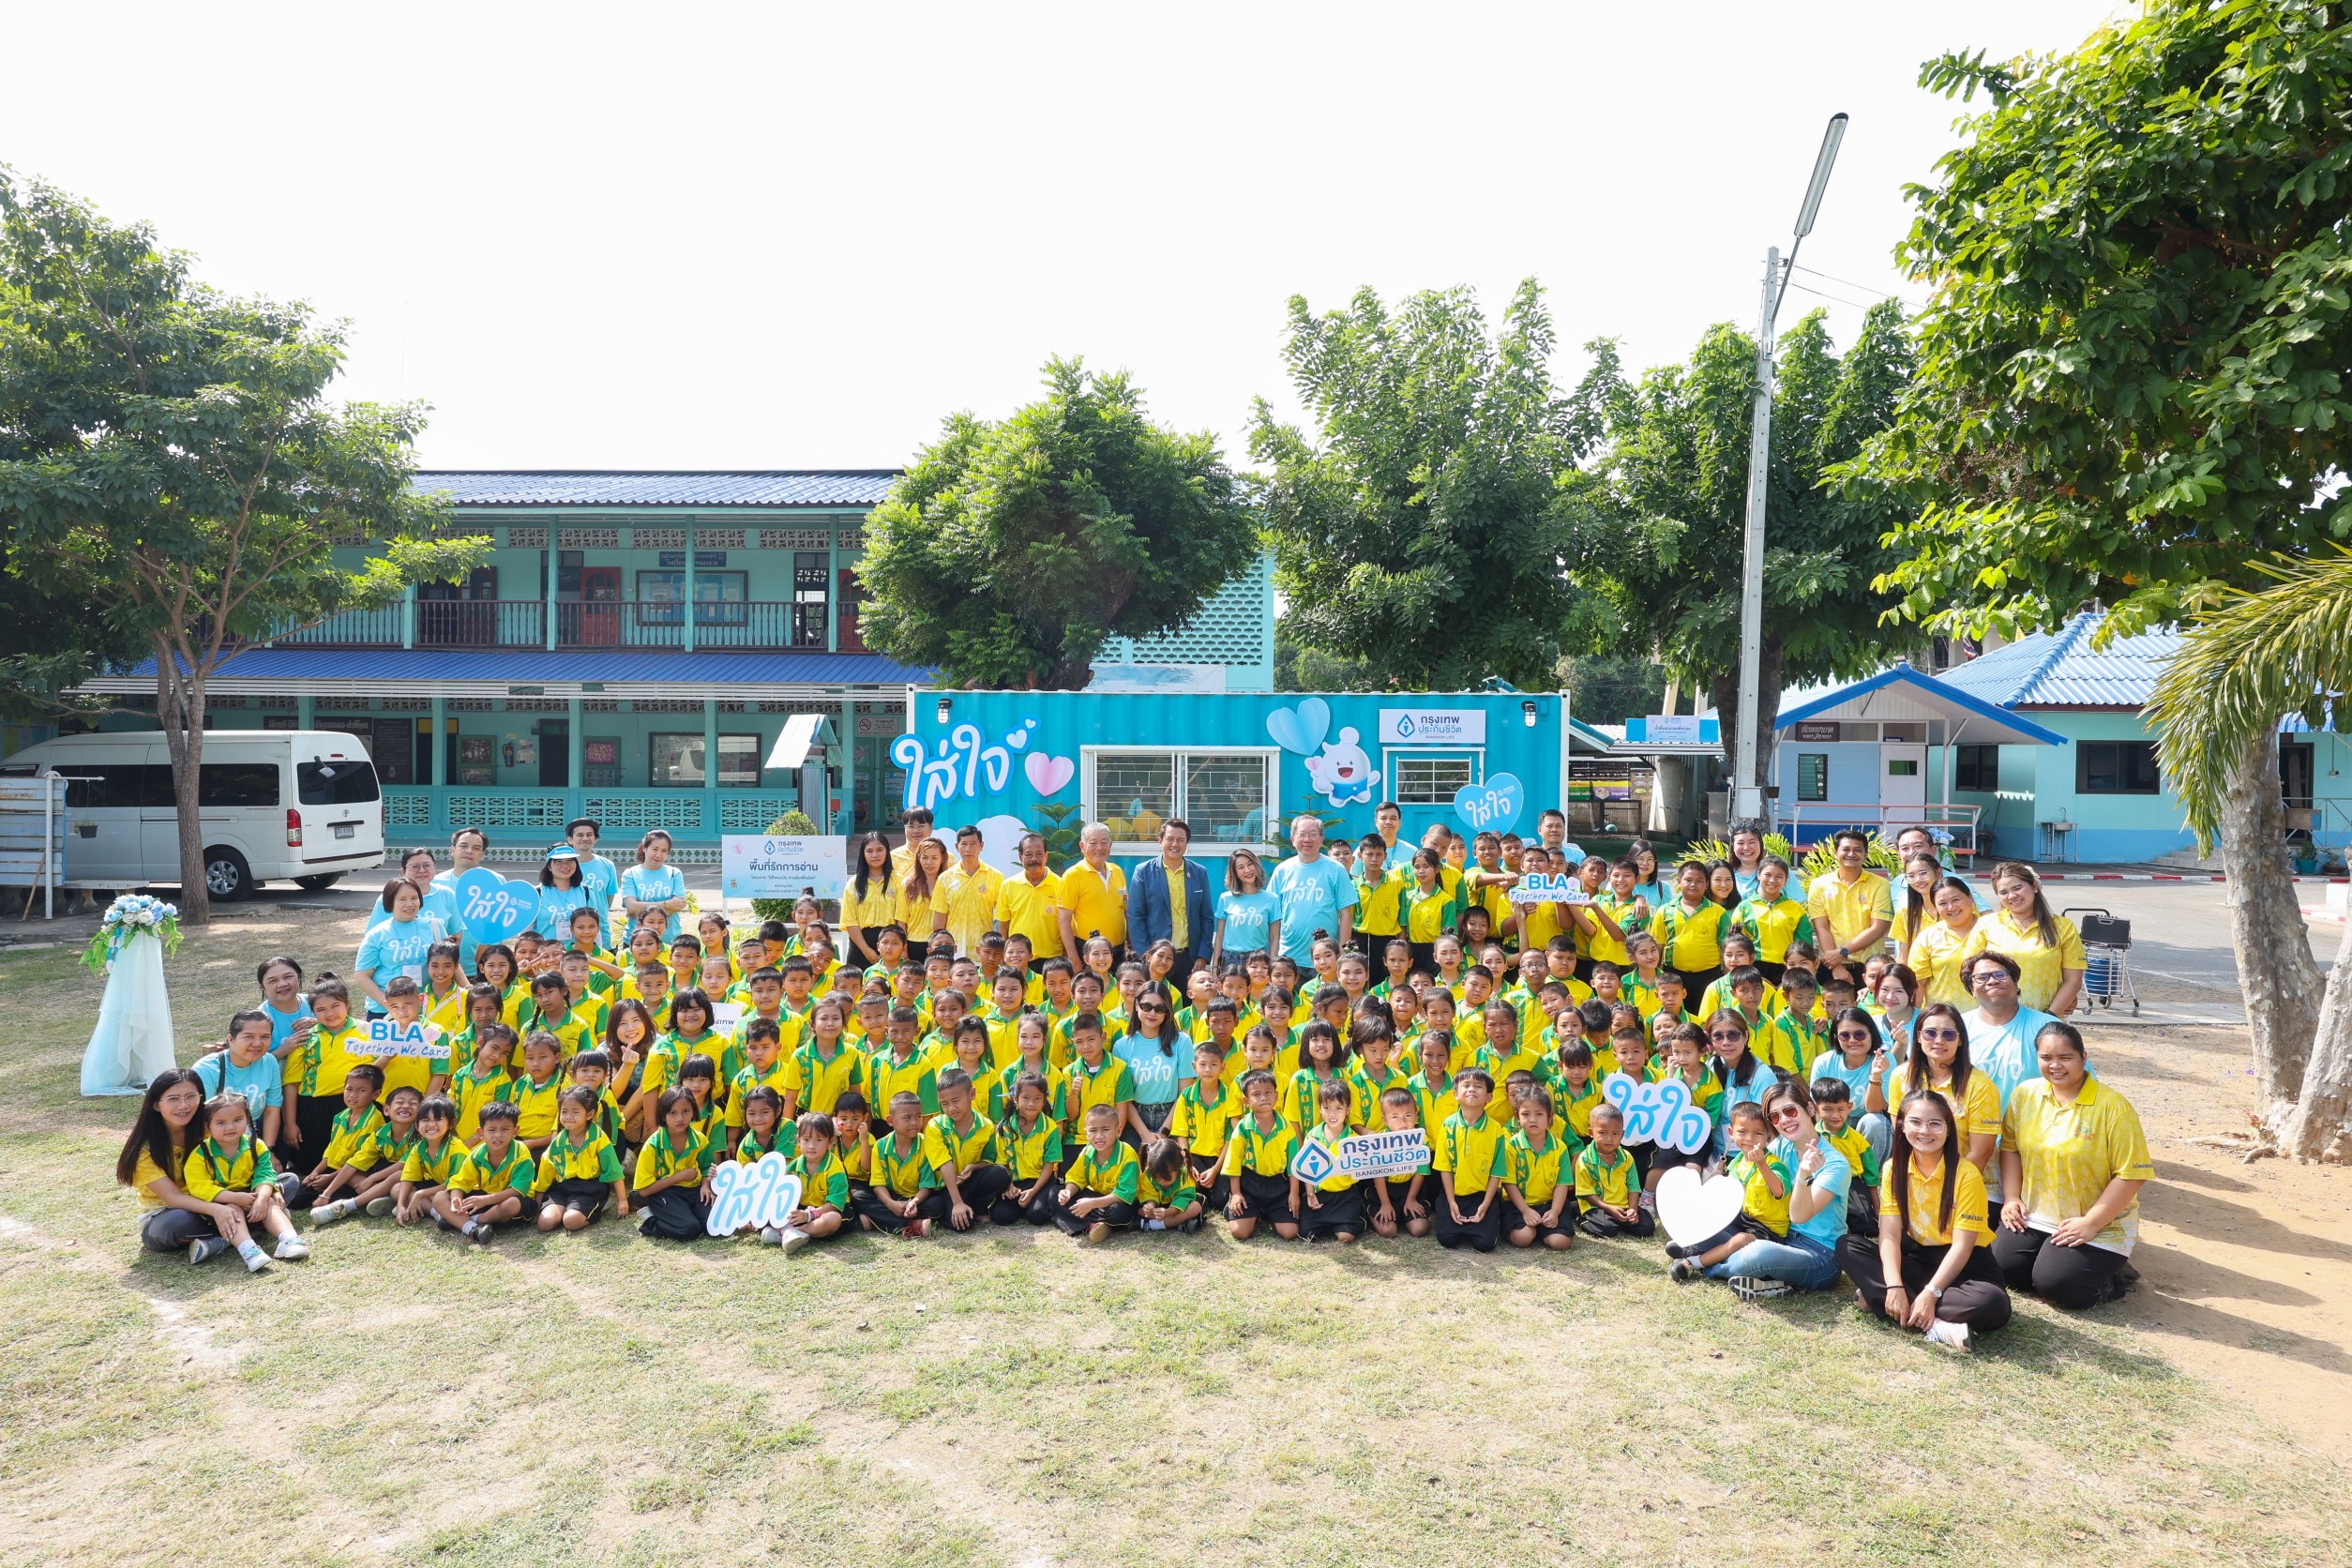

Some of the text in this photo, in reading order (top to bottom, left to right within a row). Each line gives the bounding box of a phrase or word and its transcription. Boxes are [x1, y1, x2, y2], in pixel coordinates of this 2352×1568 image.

[1418, 724, 1463, 734] ประกันชีวิต
[1421, 716, 1460, 727] กรุงเทพ
[895, 724, 1010, 810] ใส่ใจ
[1465, 791, 1511, 827] ใส่ใจ
[749, 858, 819, 872] พื้นที่รักการอ่าน
[638, 881, 671, 901] ใส่ใจ
[1528, 874, 1568, 890] BLA
[463, 884, 518, 927] ใส่ใจ
[1510, 891, 1591, 902] Together We Care
[370, 1022, 424, 1043] BLA
[346, 1040, 450, 1057] Together We Care
[1130, 1055, 1172, 1086] ใส่ใจ
[1609, 1079, 1704, 1149] ใส่ใจ
[1340, 1138, 1428, 1170] ประกันชีวิต
[1342, 1132, 1423, 1157] กรุงเทพ
[1355, 1164, 1413, 1178] BANGKOK LIFE
[713, 1159, 795, 1229] ใส่ใจ
